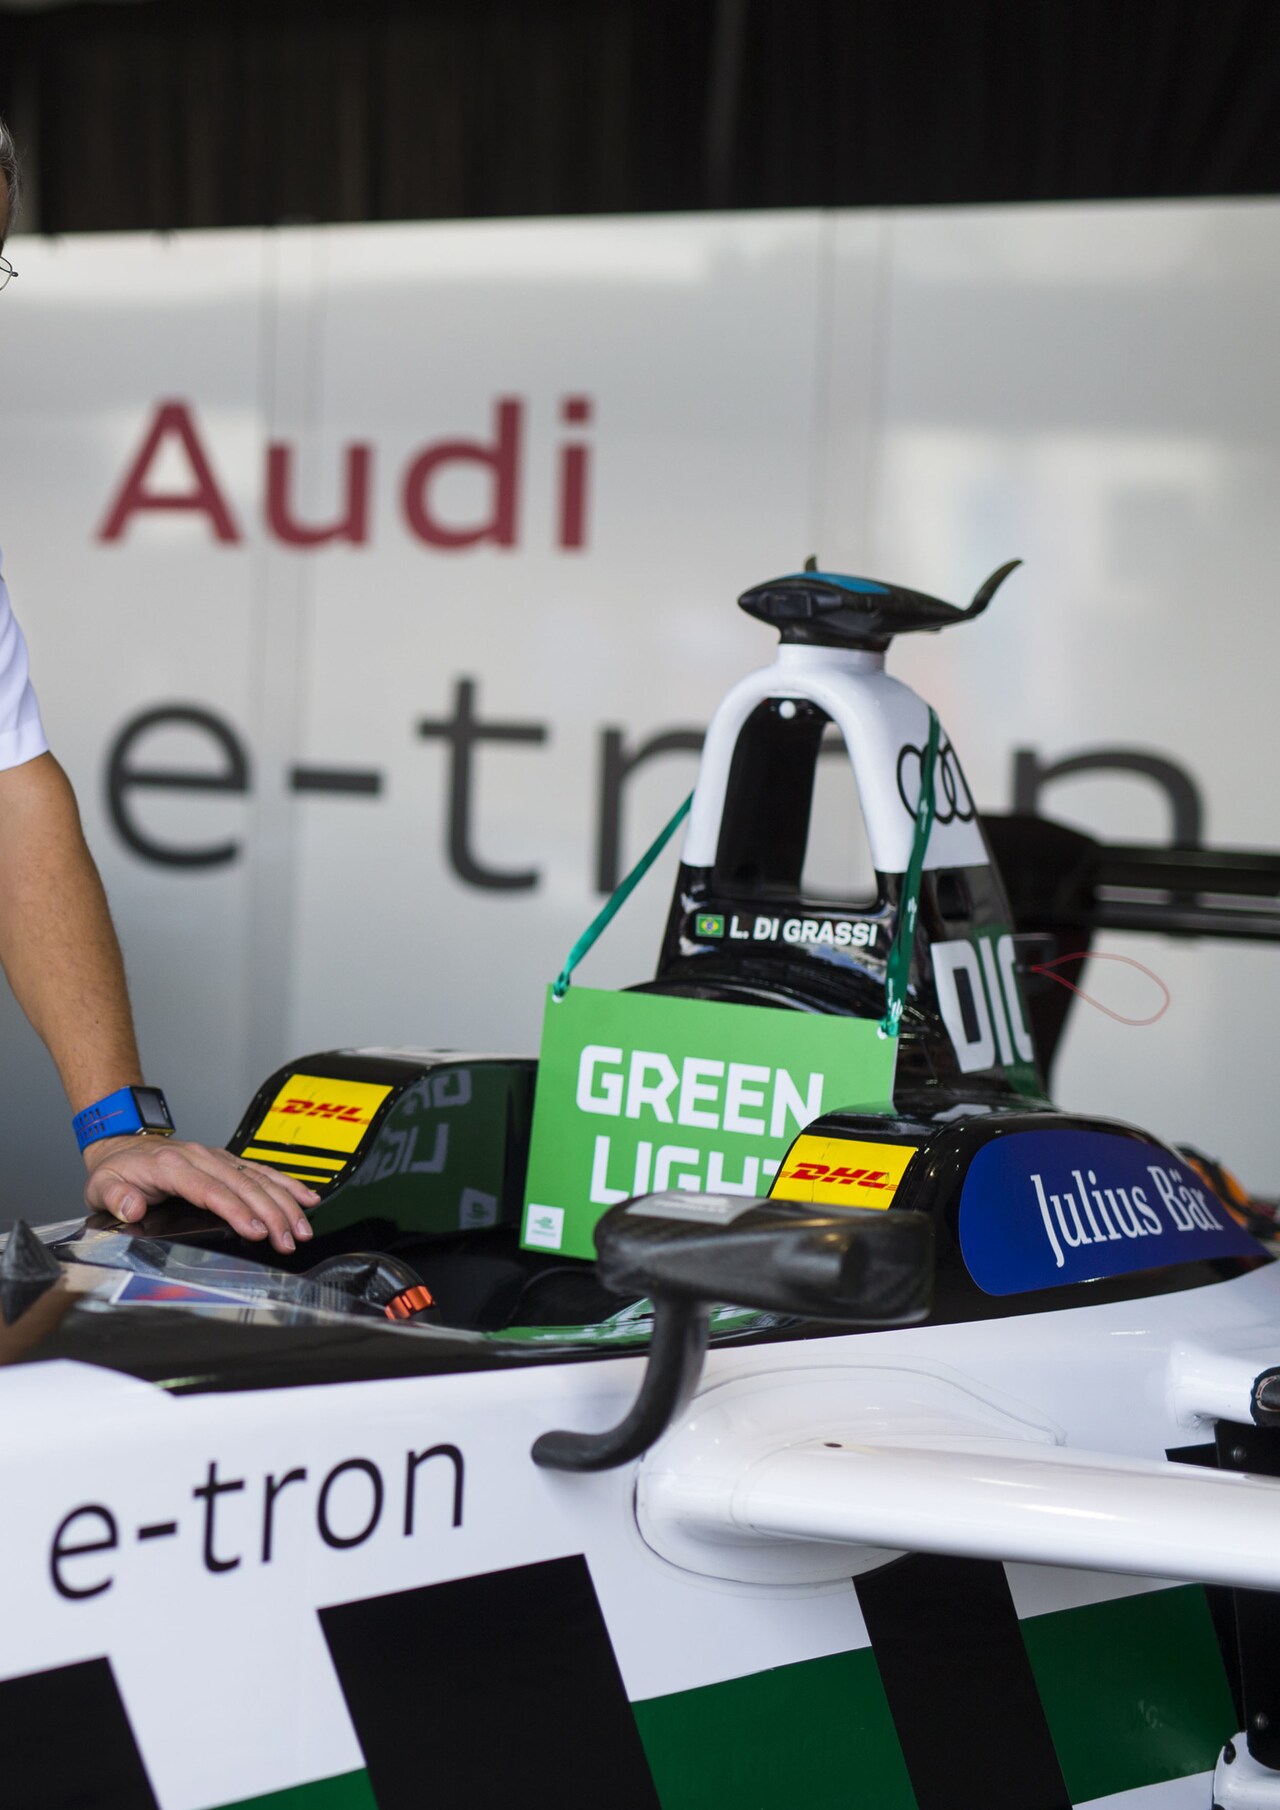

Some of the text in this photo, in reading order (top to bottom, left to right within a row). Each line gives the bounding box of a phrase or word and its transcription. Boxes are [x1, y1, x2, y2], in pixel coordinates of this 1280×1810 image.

[97, 394, 596, 555] Audi
[104, 676, 1206, 937] e-trn
[730, 915, 878, 947] L. DI GRASSI
[279, 1099, 366, 1124] DHL
[576, 1045, 824, 1138] GREEN
[590, 1135, 782, 1205] LIGH
[789, 1163, 889, 1189] DHL
[1031, 1165, 1224, 1267] Julius Bär
[48, 1443, 466, 1602] e-tron
